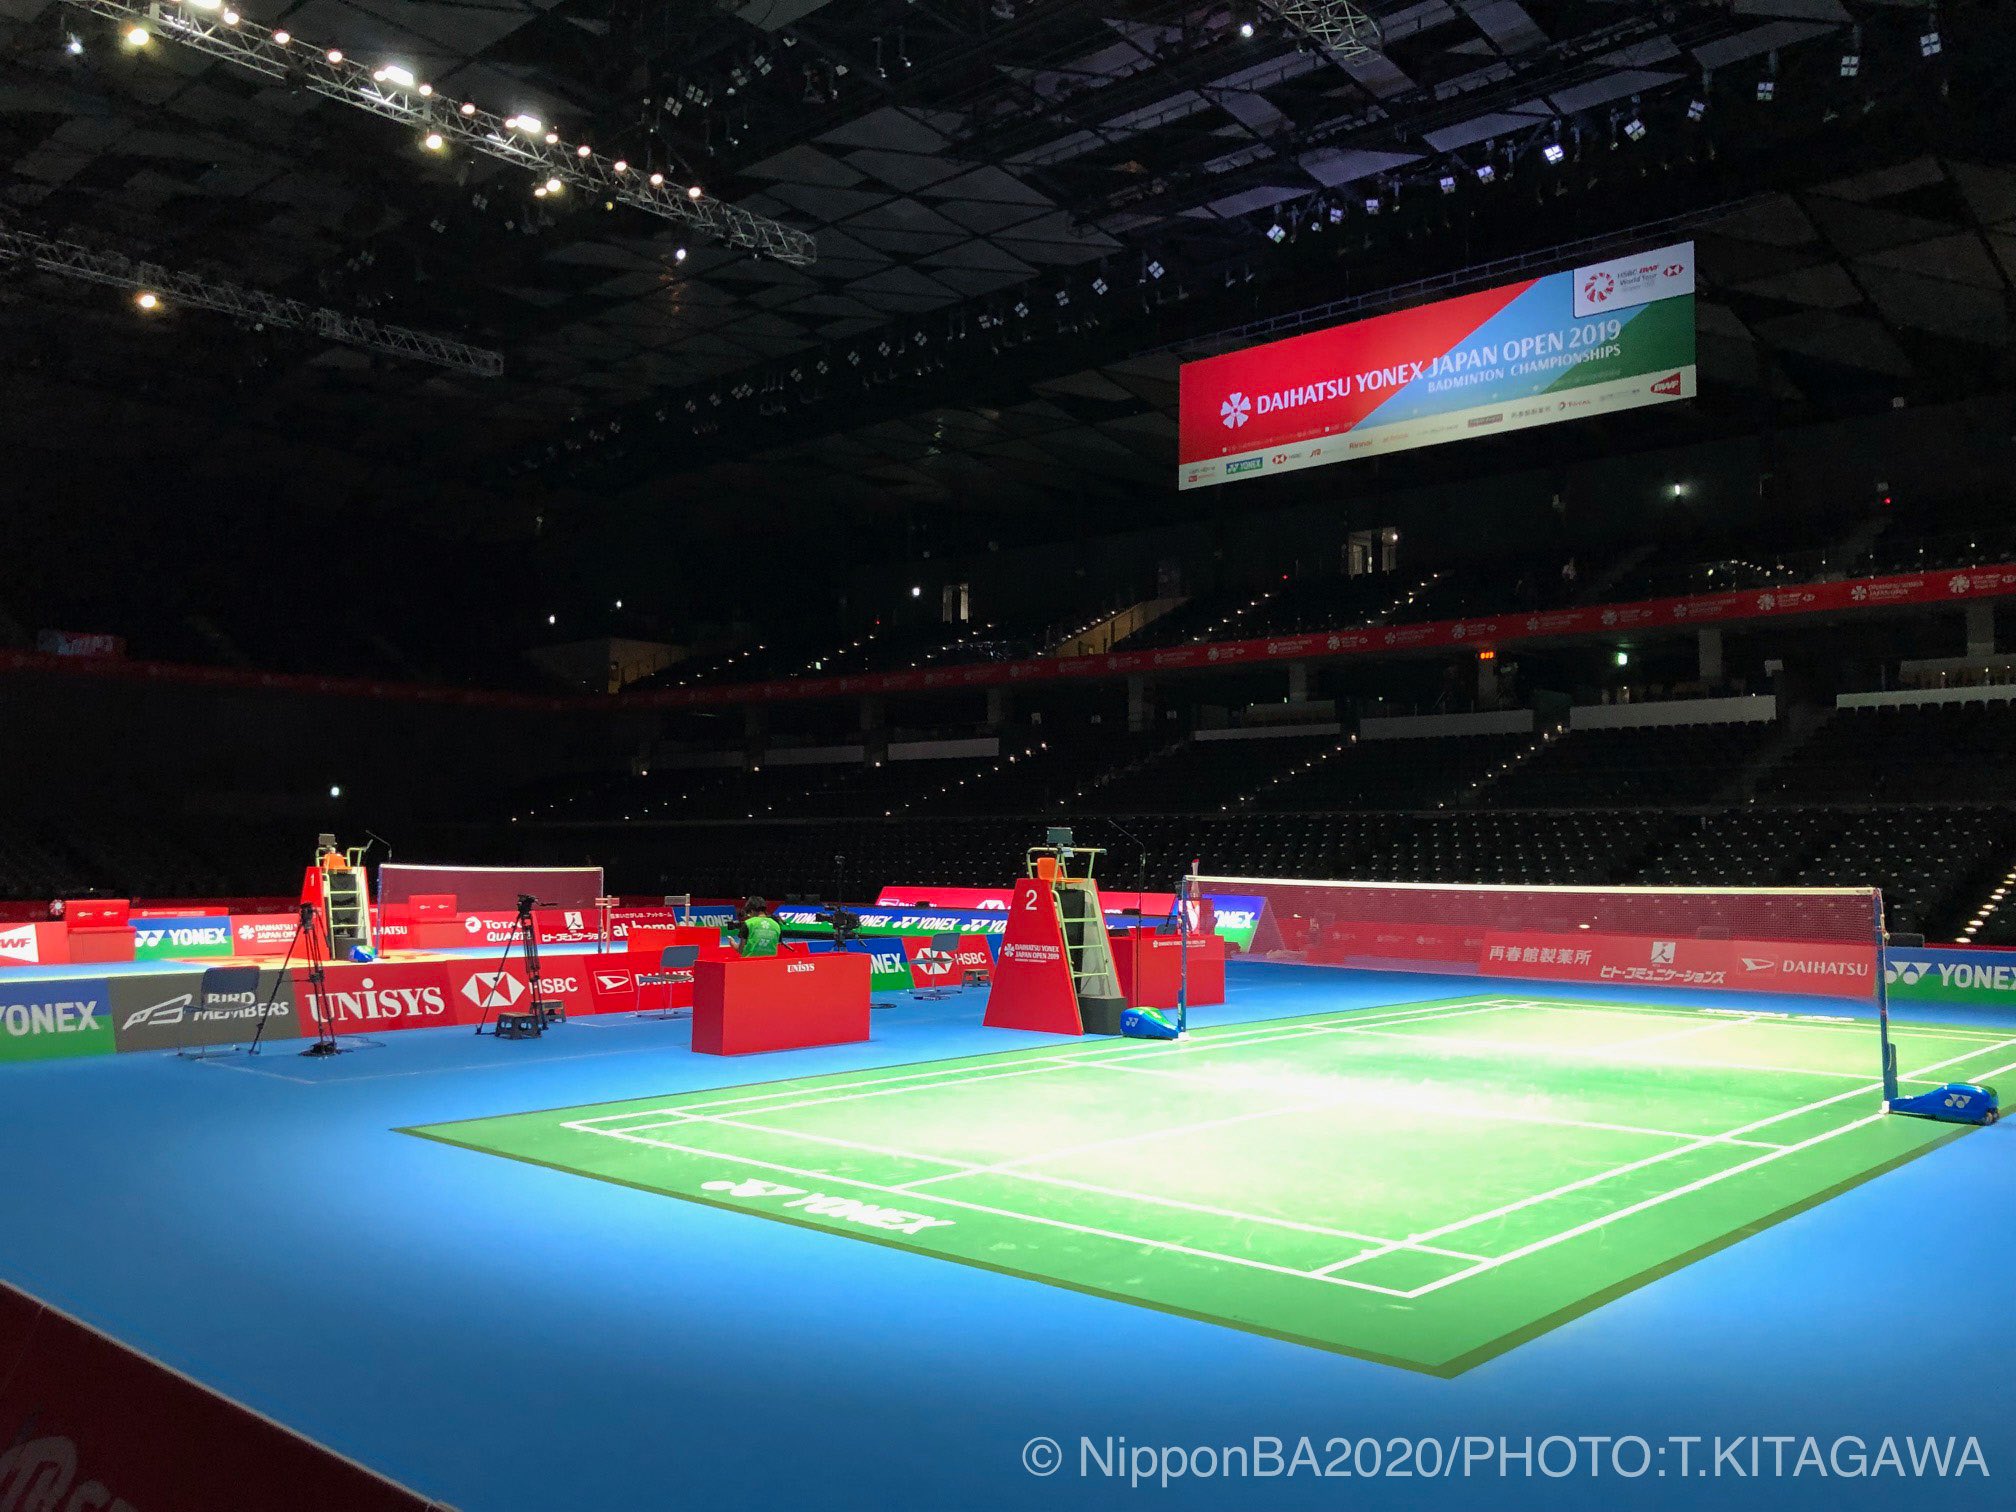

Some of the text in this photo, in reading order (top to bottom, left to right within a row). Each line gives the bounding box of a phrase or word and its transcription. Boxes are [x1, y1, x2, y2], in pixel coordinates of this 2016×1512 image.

[1257, 319, 1622, 415] DAIHATSU YONEX JAPAN OPEN 2019
[1428, 343, 1621, 393] BADMINTON CHAMPIONSHIPS
[310, 874, 315, 886] 1
[1025, 890, 1038, 910] 2
[613, 923, 629, 936] at
[917, 917, 961, 930] YONEX
[168, 928, 227, 946] YONEX
[955, 952, 987, 965] HSBC
[1782, 959, 1868, 976] DAIHATSU
[1600, 966, 1726, 985] ヒト・コミュニケーションズ
[528, 976, 579, 995] HSBC
[207, 992, 256, 1004] BIRD
[193, 1001, 290, 1022] MEMBERS
[783, 1193, 956, 1235] YONEX
